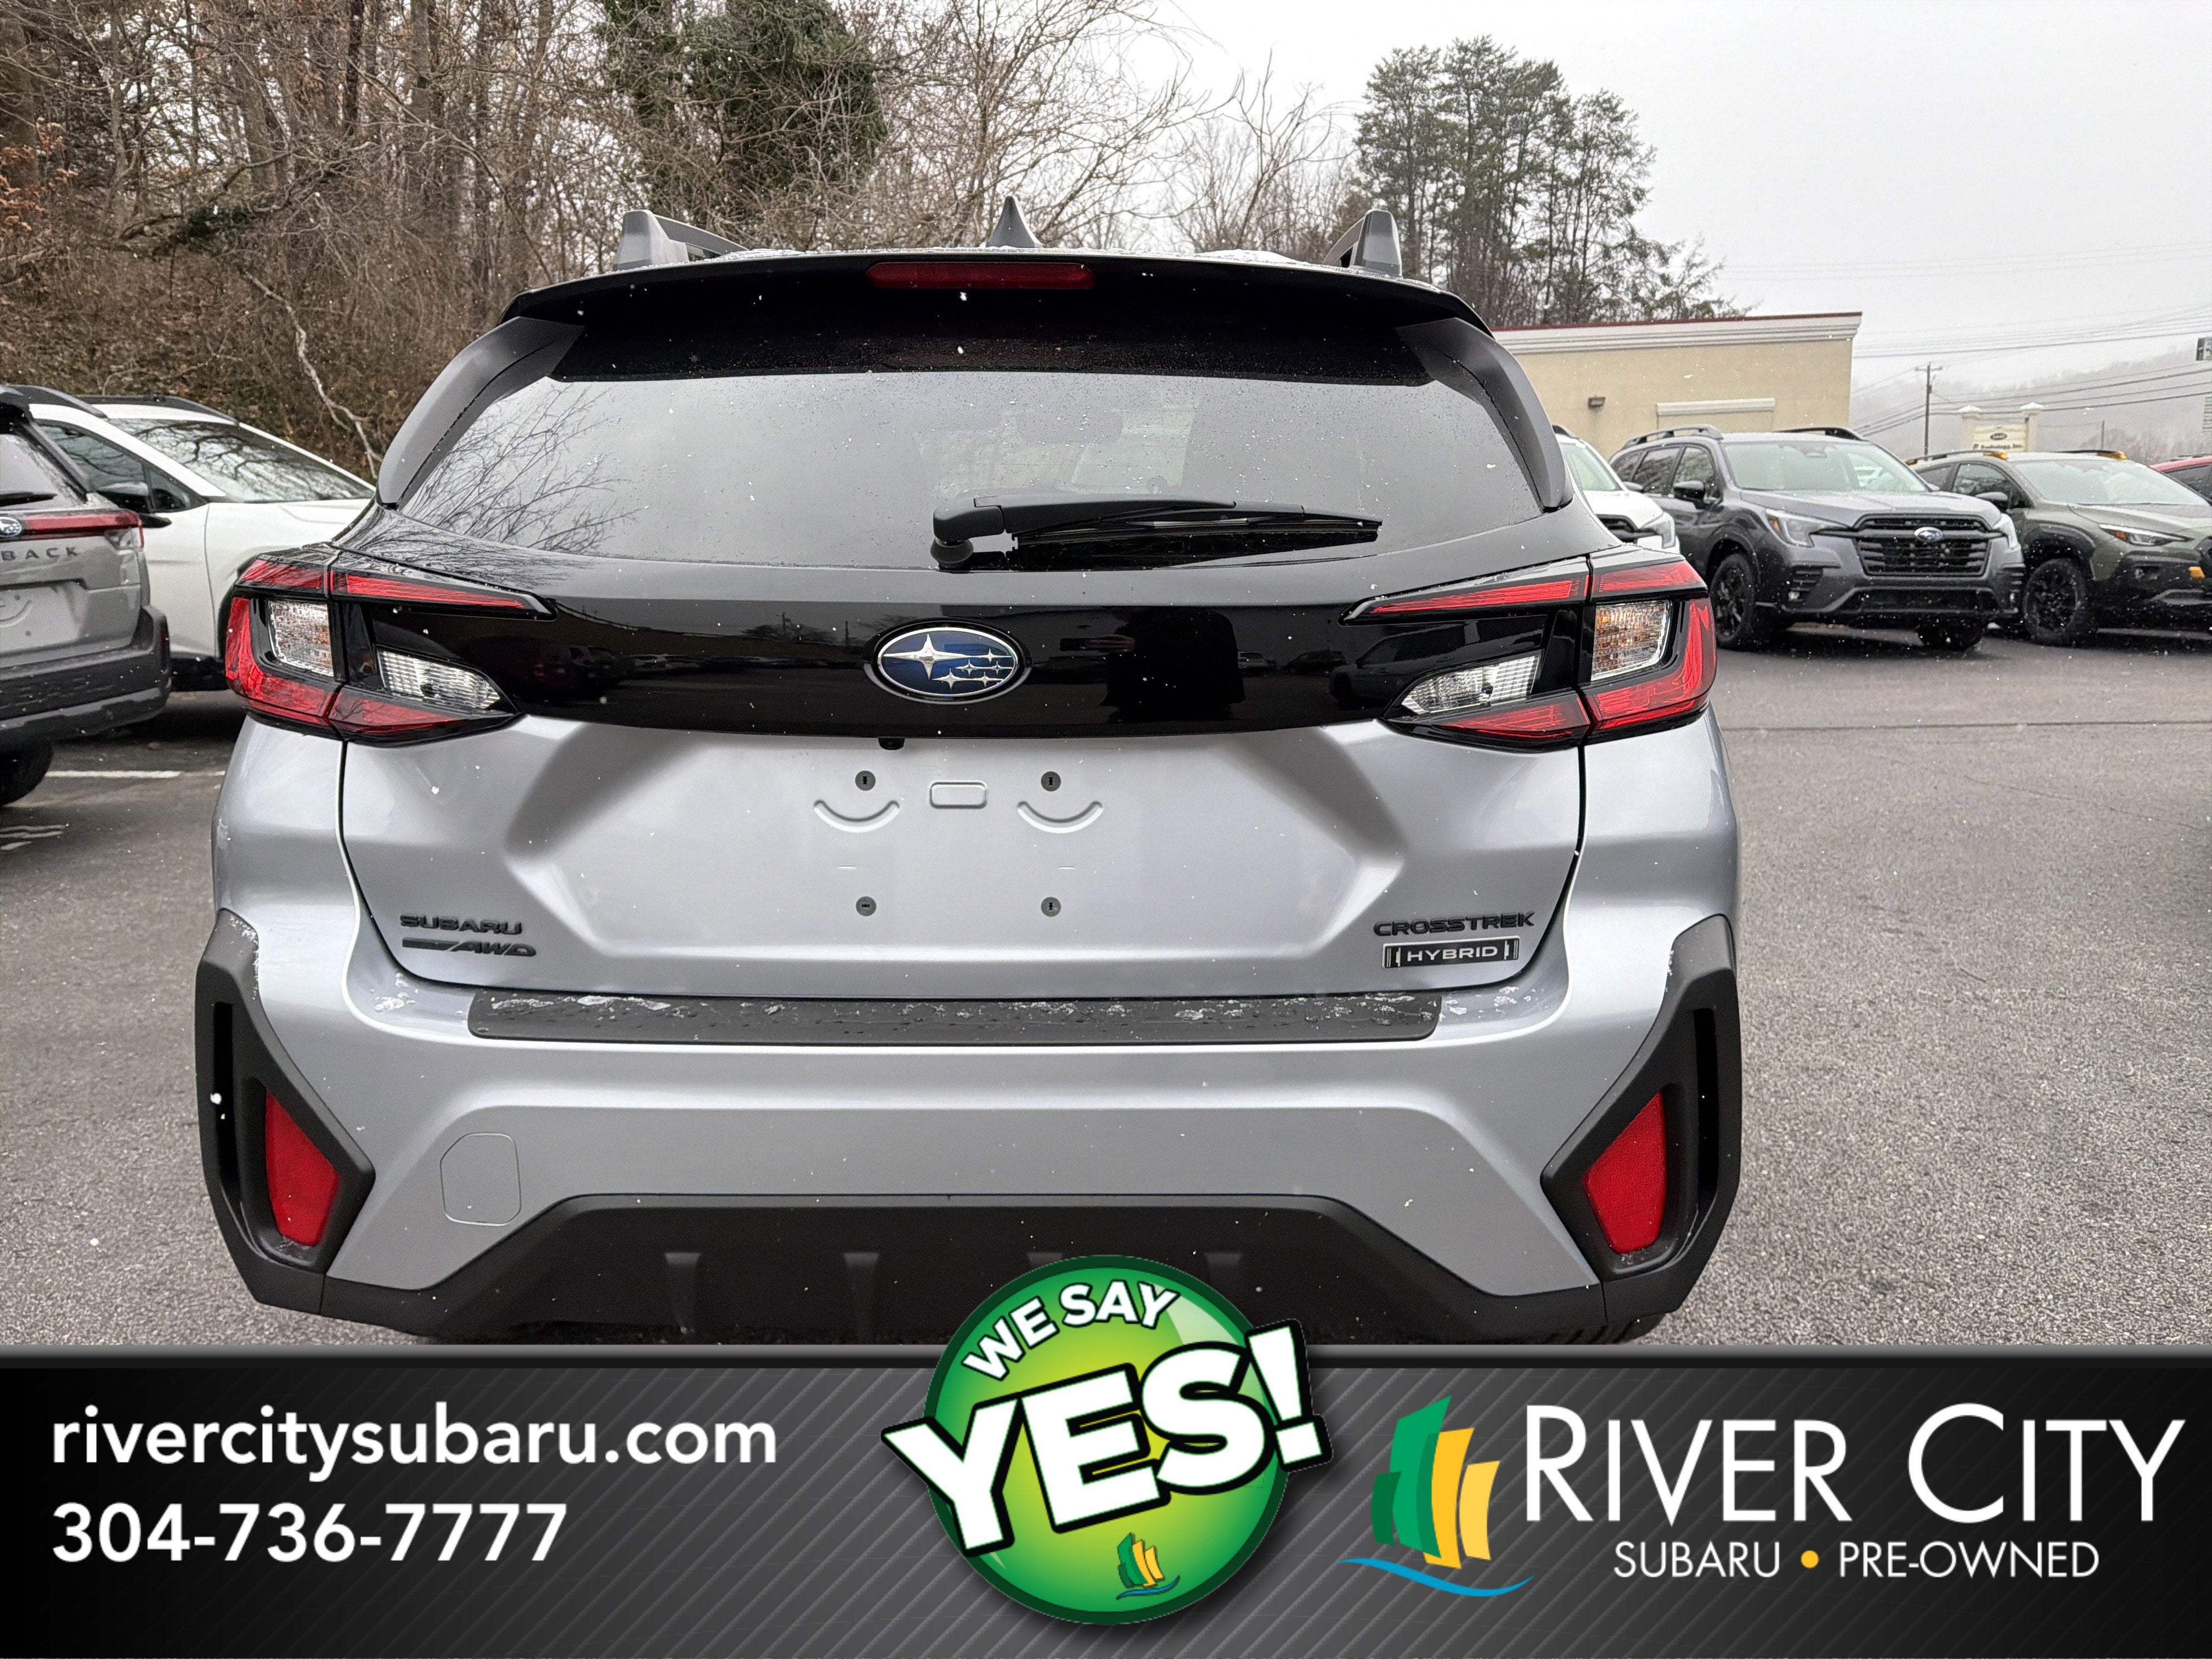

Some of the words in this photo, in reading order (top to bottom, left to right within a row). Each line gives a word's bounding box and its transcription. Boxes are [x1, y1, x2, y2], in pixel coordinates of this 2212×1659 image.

[1, 546, 78, 561] BACK
[399, 913, 522, 935] SUBARU
[1373, 911, 1535, 936] CROSSTREK
[449, 940, 537, 957] AWD
[1407, 946, 1498, 961] HYBRID
